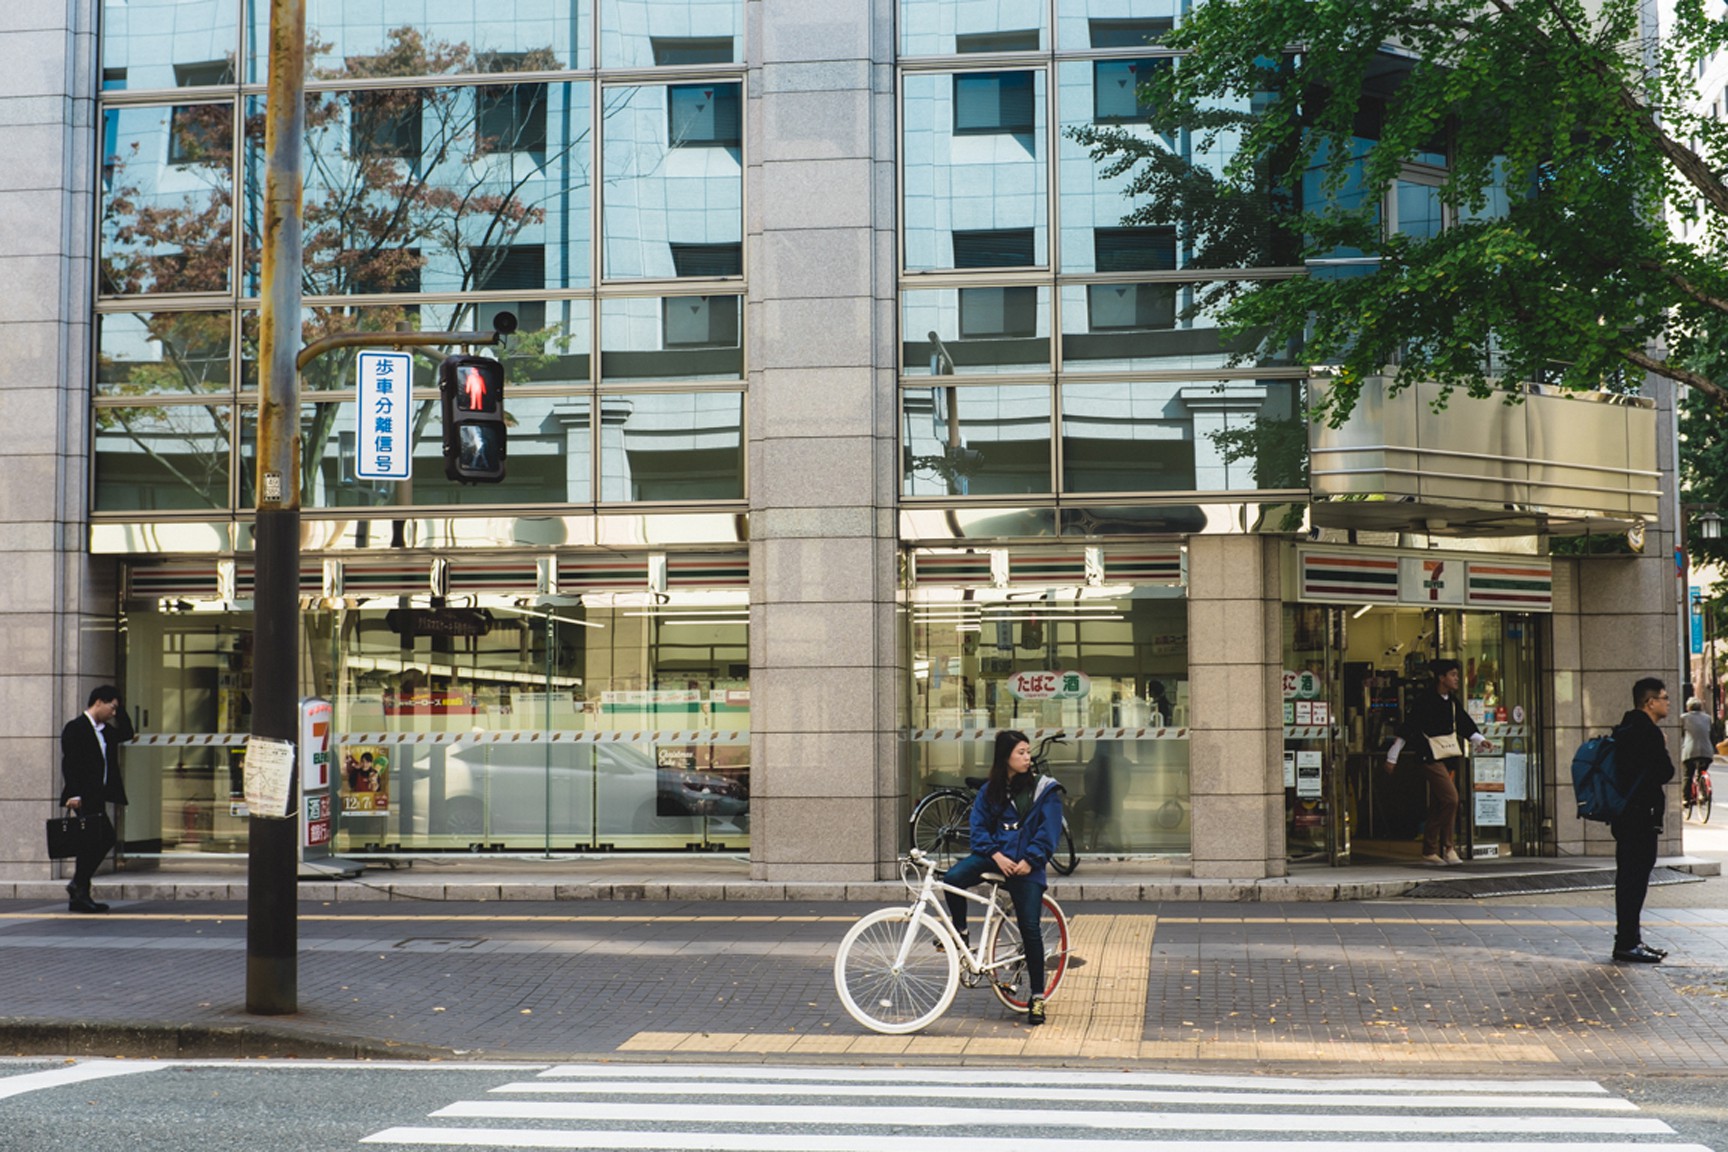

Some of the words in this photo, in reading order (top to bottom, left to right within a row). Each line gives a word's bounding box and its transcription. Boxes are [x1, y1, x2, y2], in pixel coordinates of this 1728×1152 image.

[374, 358, 394, 472] 歩車分離信号
[1423, 560, 1444, 601] 7
[1017, 675, 1056, 692] たばこ
[1063, 675, 1080, 692] 酒
[1301, 674, 1313, 691] 酒
